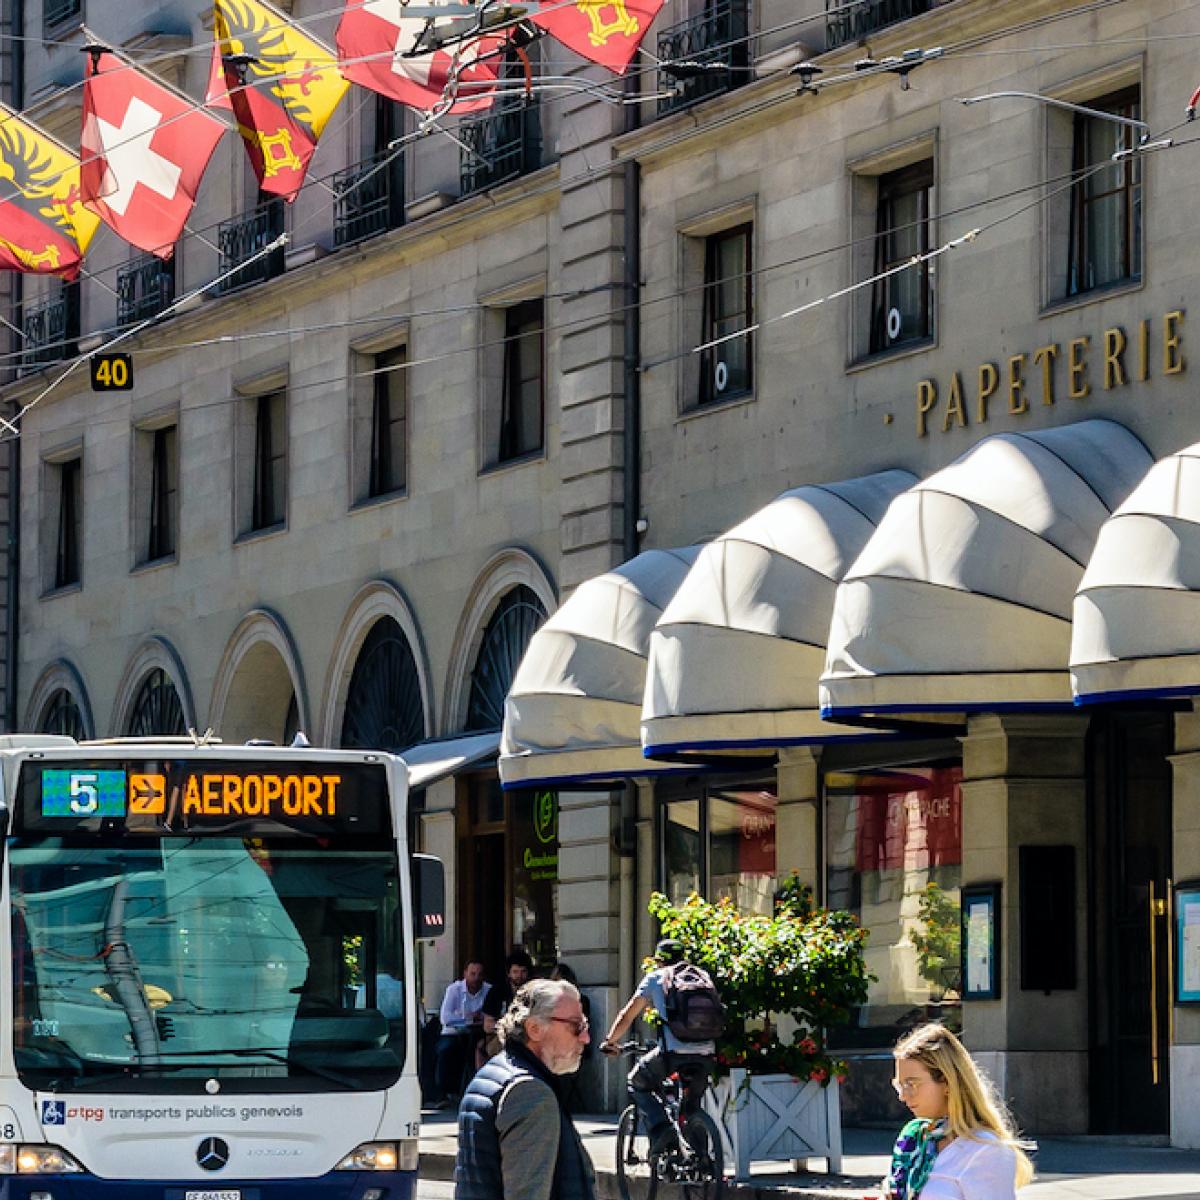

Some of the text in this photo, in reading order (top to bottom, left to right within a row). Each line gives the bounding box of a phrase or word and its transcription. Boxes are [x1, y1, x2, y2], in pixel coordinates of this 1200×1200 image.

[96, 358, 128, 386] 40
[917, 310, 1185, 438] PAPETERIE
[69, 773, 341, 815] 5 AEROPORT
[79, 1104, 304, 1121] tpg transports publics genevois
